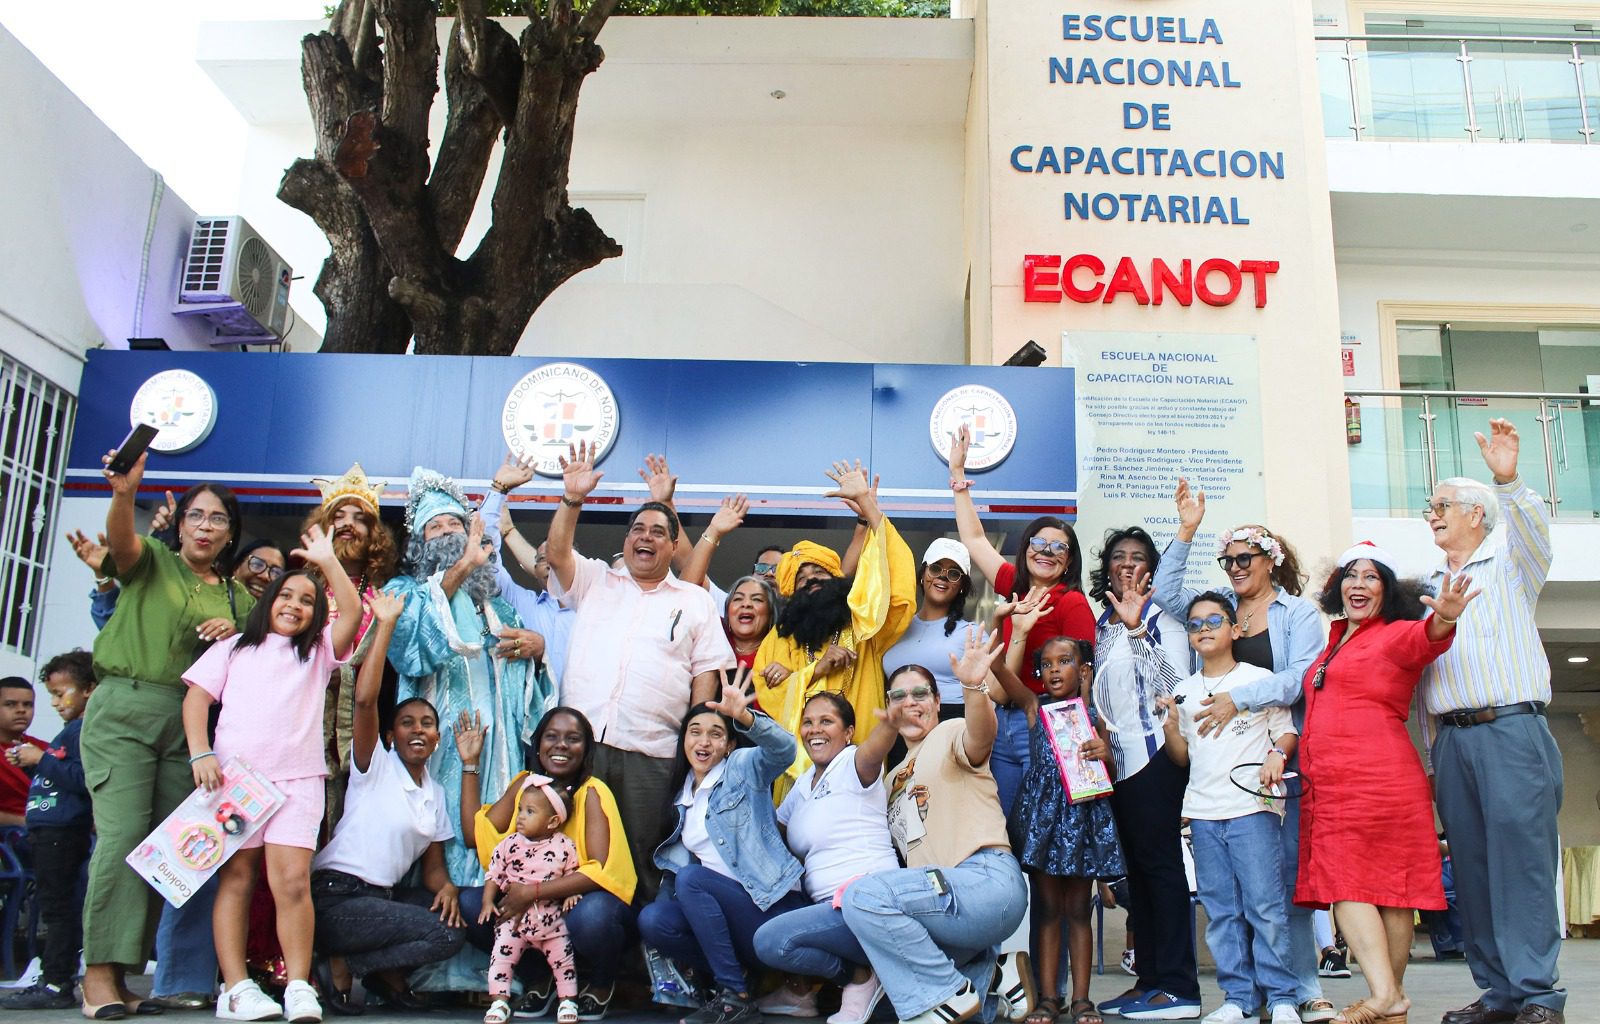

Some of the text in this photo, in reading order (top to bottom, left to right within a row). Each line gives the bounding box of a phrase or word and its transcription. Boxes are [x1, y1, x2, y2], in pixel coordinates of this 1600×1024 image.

[1062, 14, 1223, 44] ESCUELA
[1049, 57, 1241, 88] NACIONAL
[1123, 102, 1171, 130] DE
[1010, 145, 1285, 179] CAPACITACION
[1064, 192, 1250, 225] NOTARIAL
[1023, 253, 1280, 308] ECANOT
[1101, 351, 1219, 362] ESCUELA NACIONAL
[1152, 363, 1168, 372] DE
[514, 367, 589, 399] DOMINICANO
[589, 379, 605, 395] DE
[1087, 373, 1234, 385] CAPACITACION NOTARIAL
[157, 861, 192, 898] Cooking
